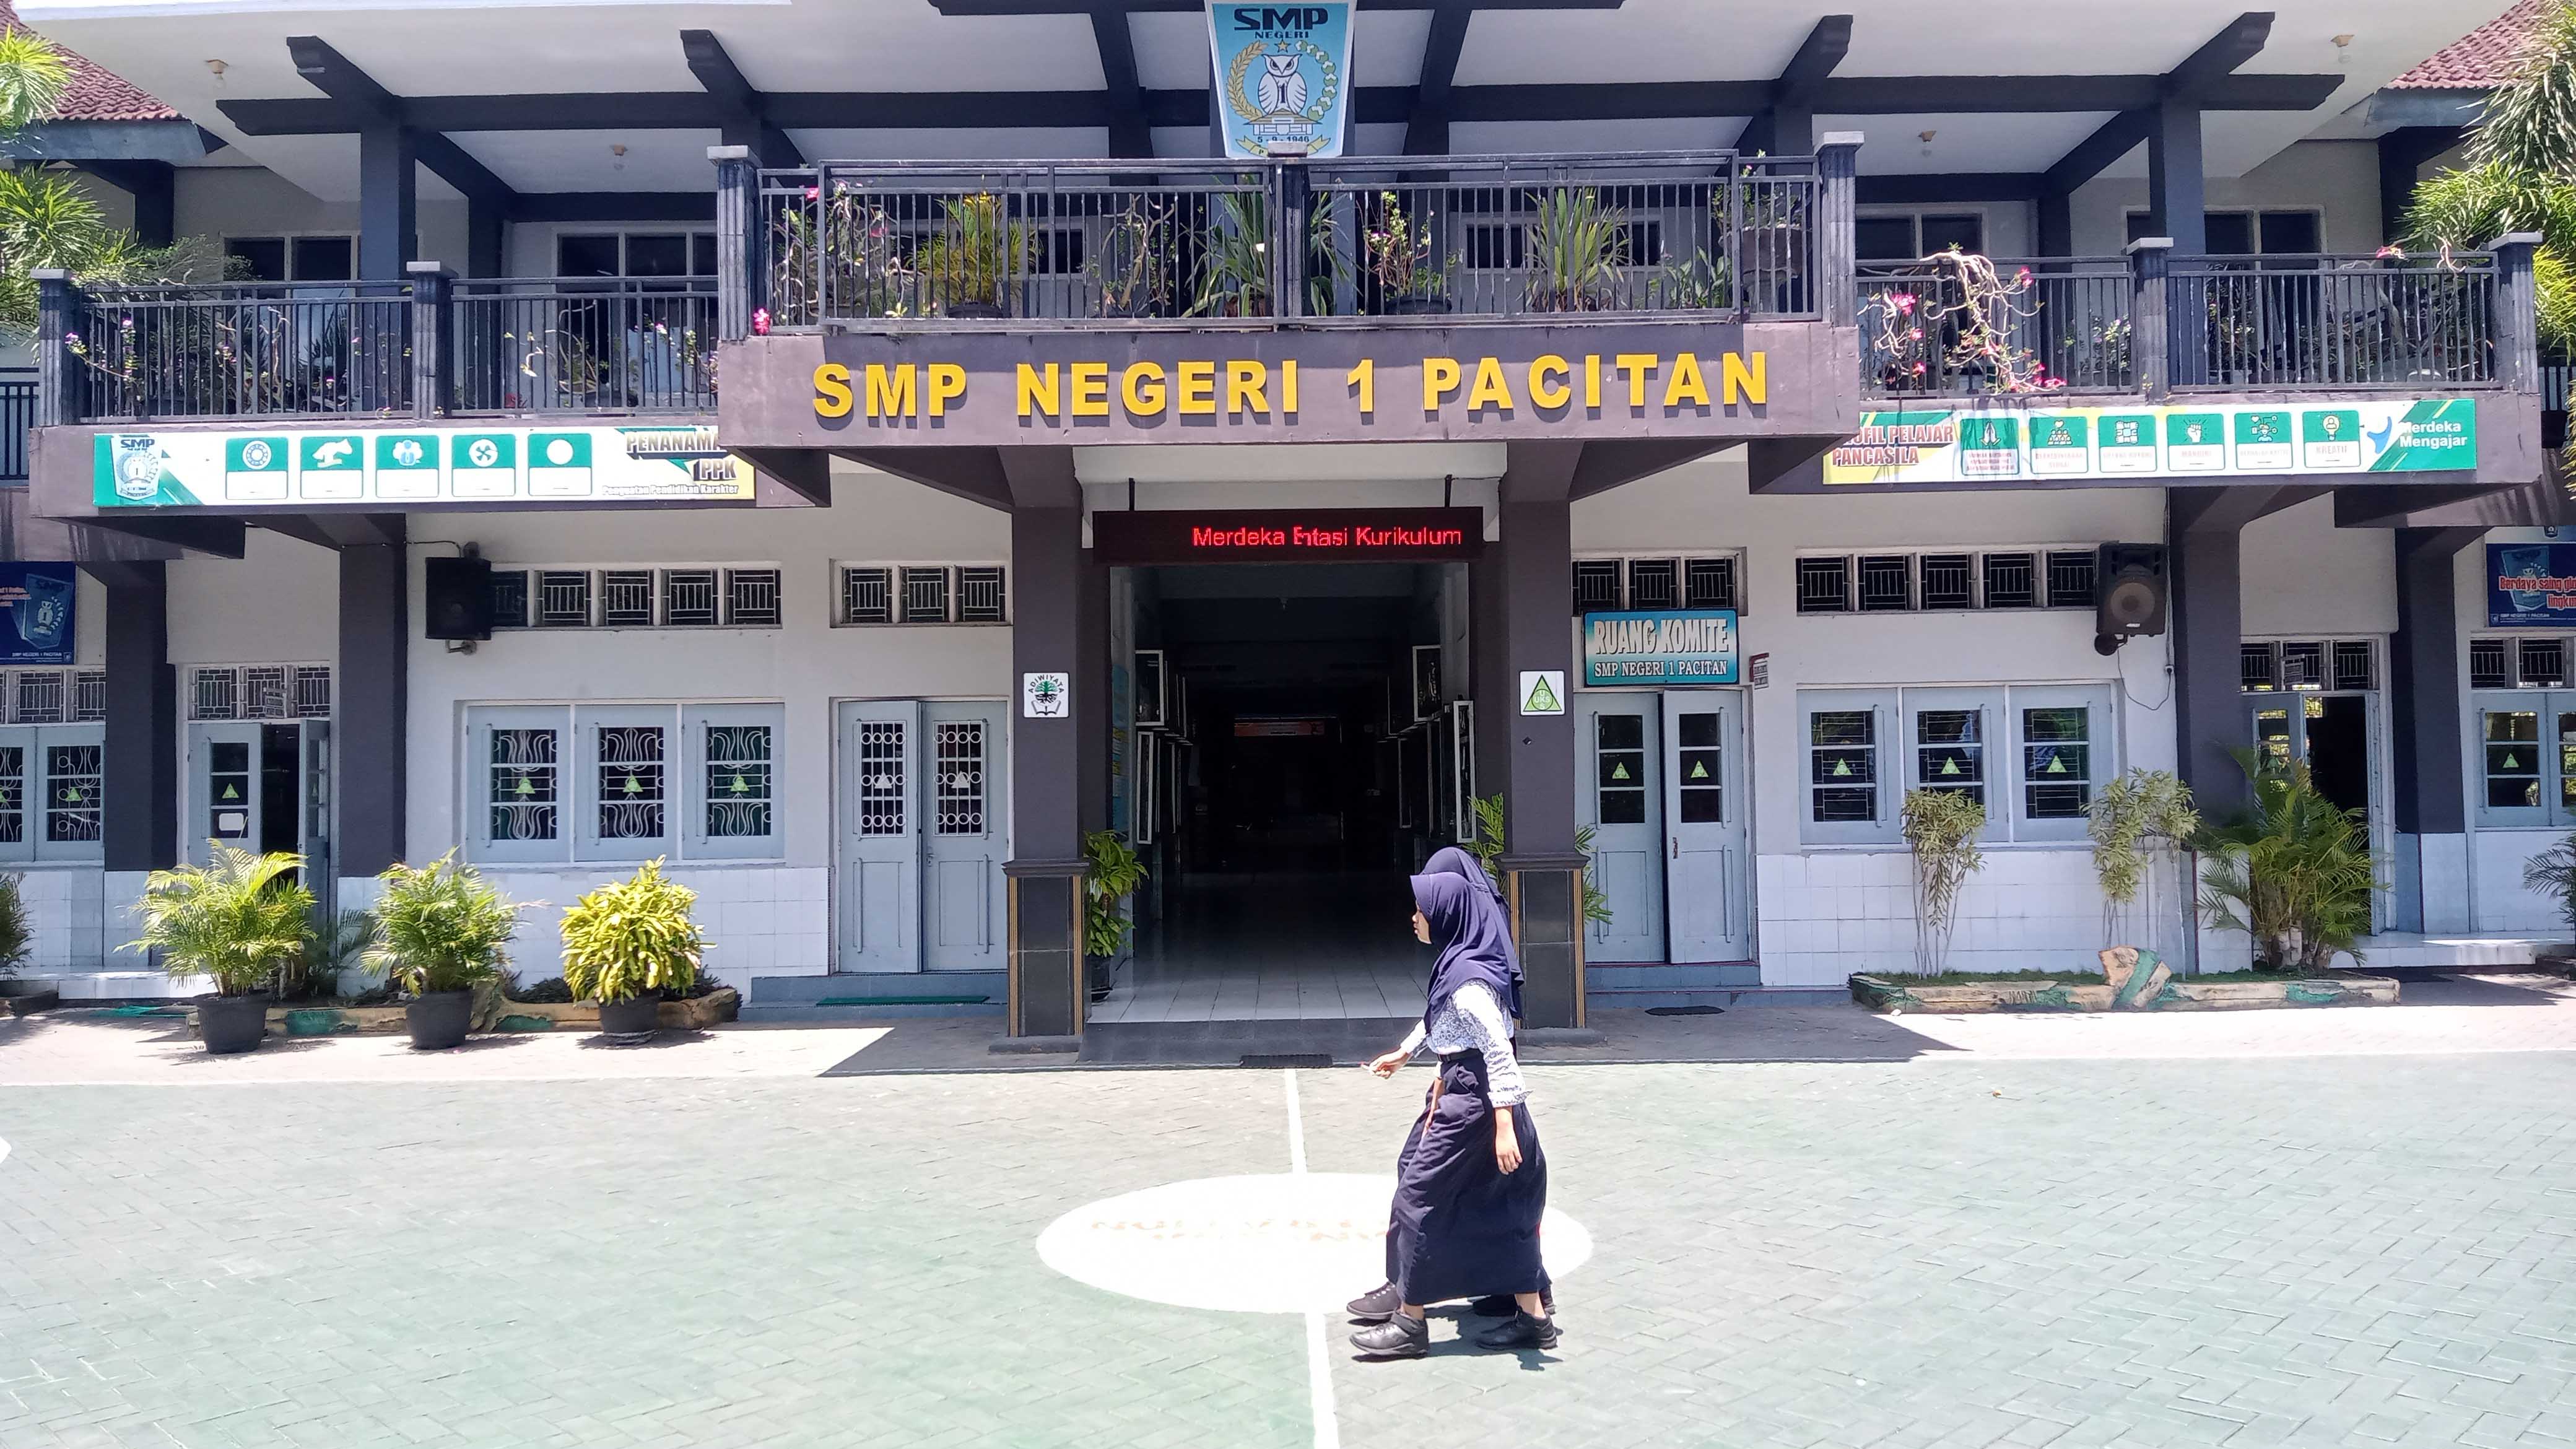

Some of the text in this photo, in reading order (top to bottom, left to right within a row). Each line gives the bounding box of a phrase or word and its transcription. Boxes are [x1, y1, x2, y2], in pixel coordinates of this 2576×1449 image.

[1234, 7, 1328, 31] SMP
[1278, 82, 1287, 103] 1
[813, 352, 1767, 417] SMP NEGERI 1 PACITAN
[1889, 425, 1954, 443] PELAJAR
[2399, 421, 2461, 433] Merdeka
[120, 438, 155, 448] SMP
[2400, 435, 2468, 450] Mengajar
[1832, 446, 1920, 466] PANCASILA
[701, 459, 737, 479] PPK
[650, 484, 700, 495] Pendidikan
[700, 484, 739, 494] Karakter
[1193, 527, 1285, 546] Merdeka
[1356, 526, 1461, 546] Kurikulum
[2499, 577, 2537, 592] Berdaya
[2538, 576, 2562, 593] saing
[1594, 619, 1729, 655] RUANG KOMITE
[1595, 660, 1728, 677] SMP NEGERI 1 PACITAN
[1028, 674, 1064, 694] ADIWIYATA
